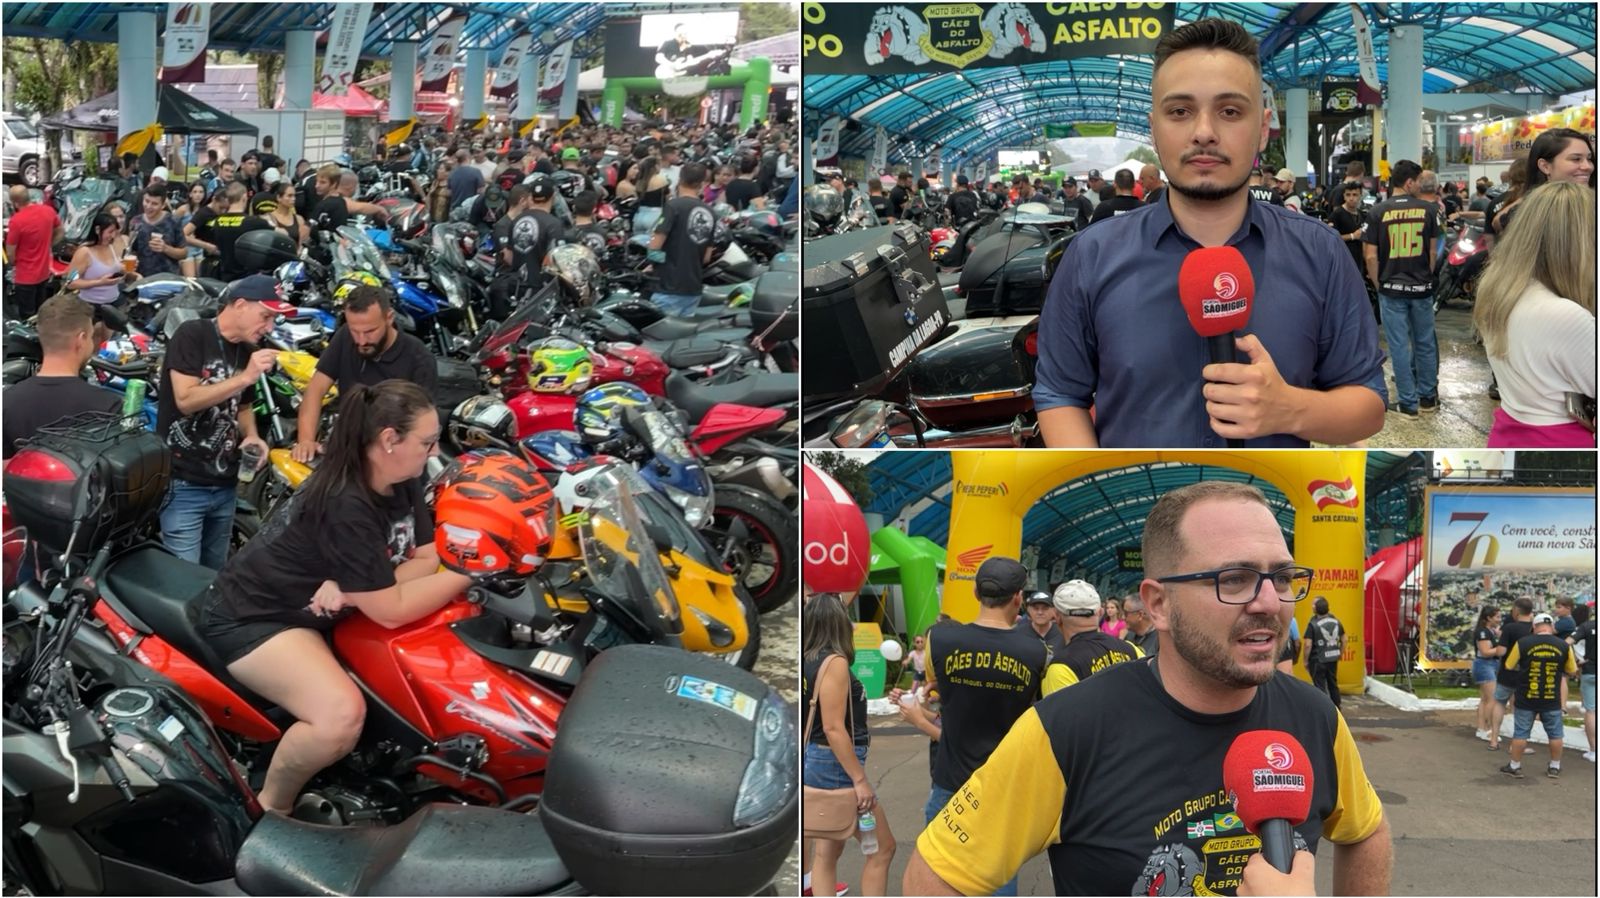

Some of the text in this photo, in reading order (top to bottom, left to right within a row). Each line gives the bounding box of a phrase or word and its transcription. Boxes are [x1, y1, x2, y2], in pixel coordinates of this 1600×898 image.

[930, 6, 975, 16] MOTO GRUPO
[1053, 17, 1161, 45] ASFALTO
[935, 38, 980, 48] ASFALTO
[1382, 208, 1426, 222] ARTHUR
[1388, 222, 1424, 259] 005
[1312, 515, 1332, 523] SANTA
[1501, 524, 1527, 536] Com
[1530, 524, 1558, 538] você,
[1517, 540, 1545, 549] uma
[1547, 540, 1576, 549] nova
[1319, 569, 1358, 580] YAMAHA
[975, 652, 991, 668] DO
[993, 651, 1031, 686] ASFALTO
[1154, 808, 1183, 840] MOTO
[1184, 793, 1216, 817] GRUPO
[1208, 839, 1255, 850] MOTO GRUPO
[1226, 866, 1242, 875] DO
